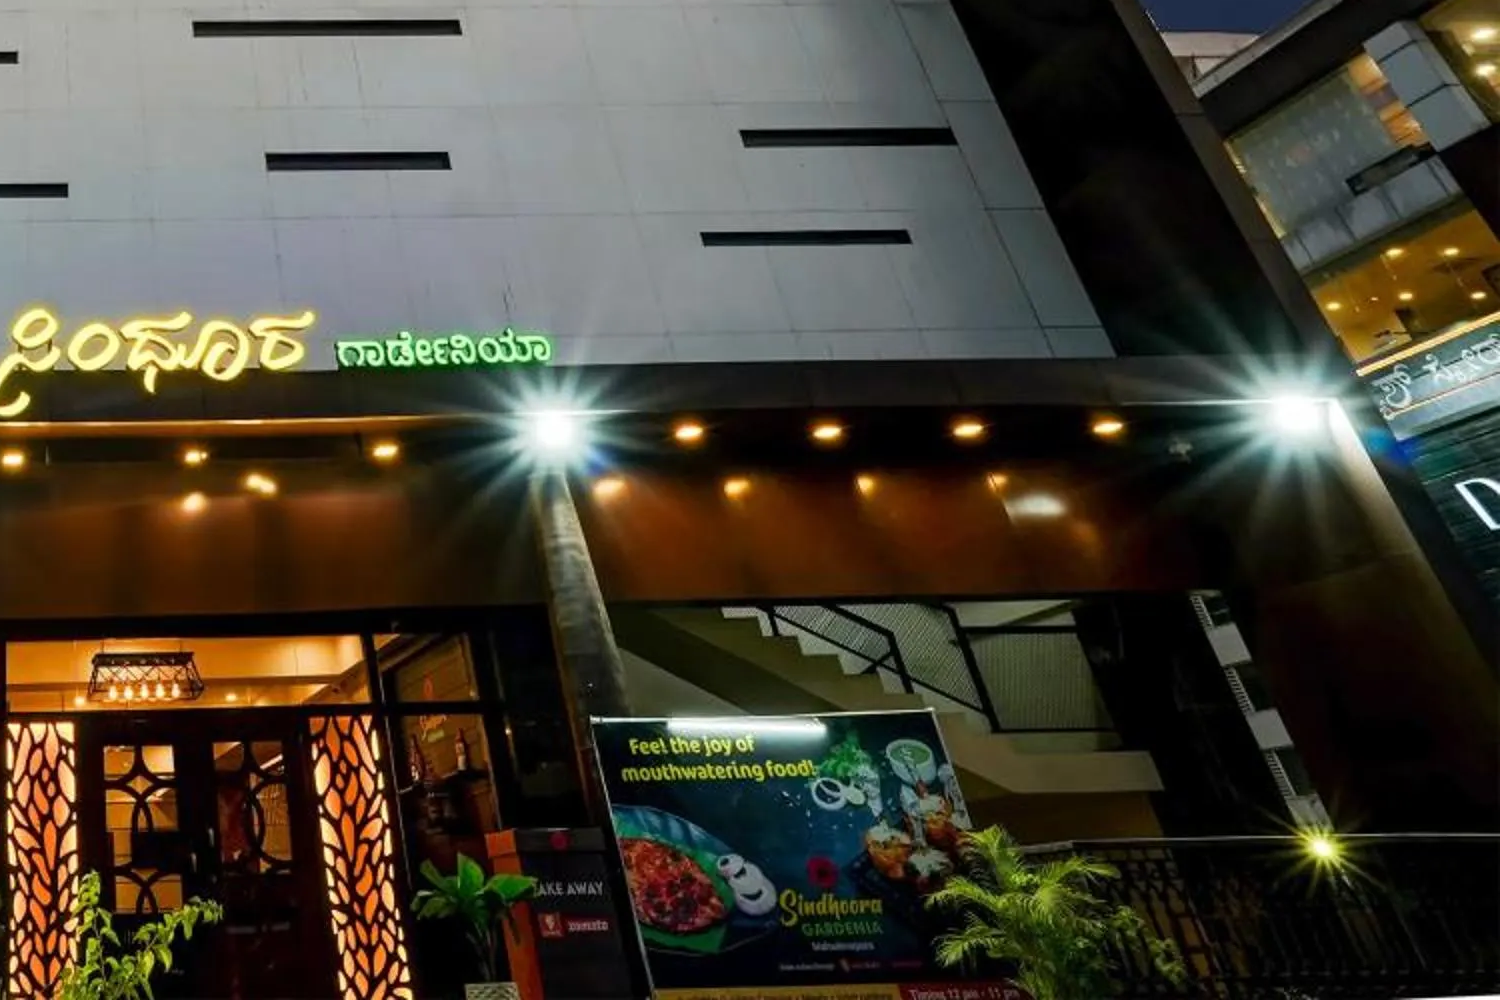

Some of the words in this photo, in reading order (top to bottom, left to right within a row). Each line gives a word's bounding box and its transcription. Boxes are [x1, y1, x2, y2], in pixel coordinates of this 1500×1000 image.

[628, 737, 668, 755] Feel
[670, 735, 701, 754] the
[703, 735, 732, 757] joy
[736, 734, 755, 753] of
[620, 760, 764, 782] mouthwatering
[567, 881, 604, 897] AWAY
